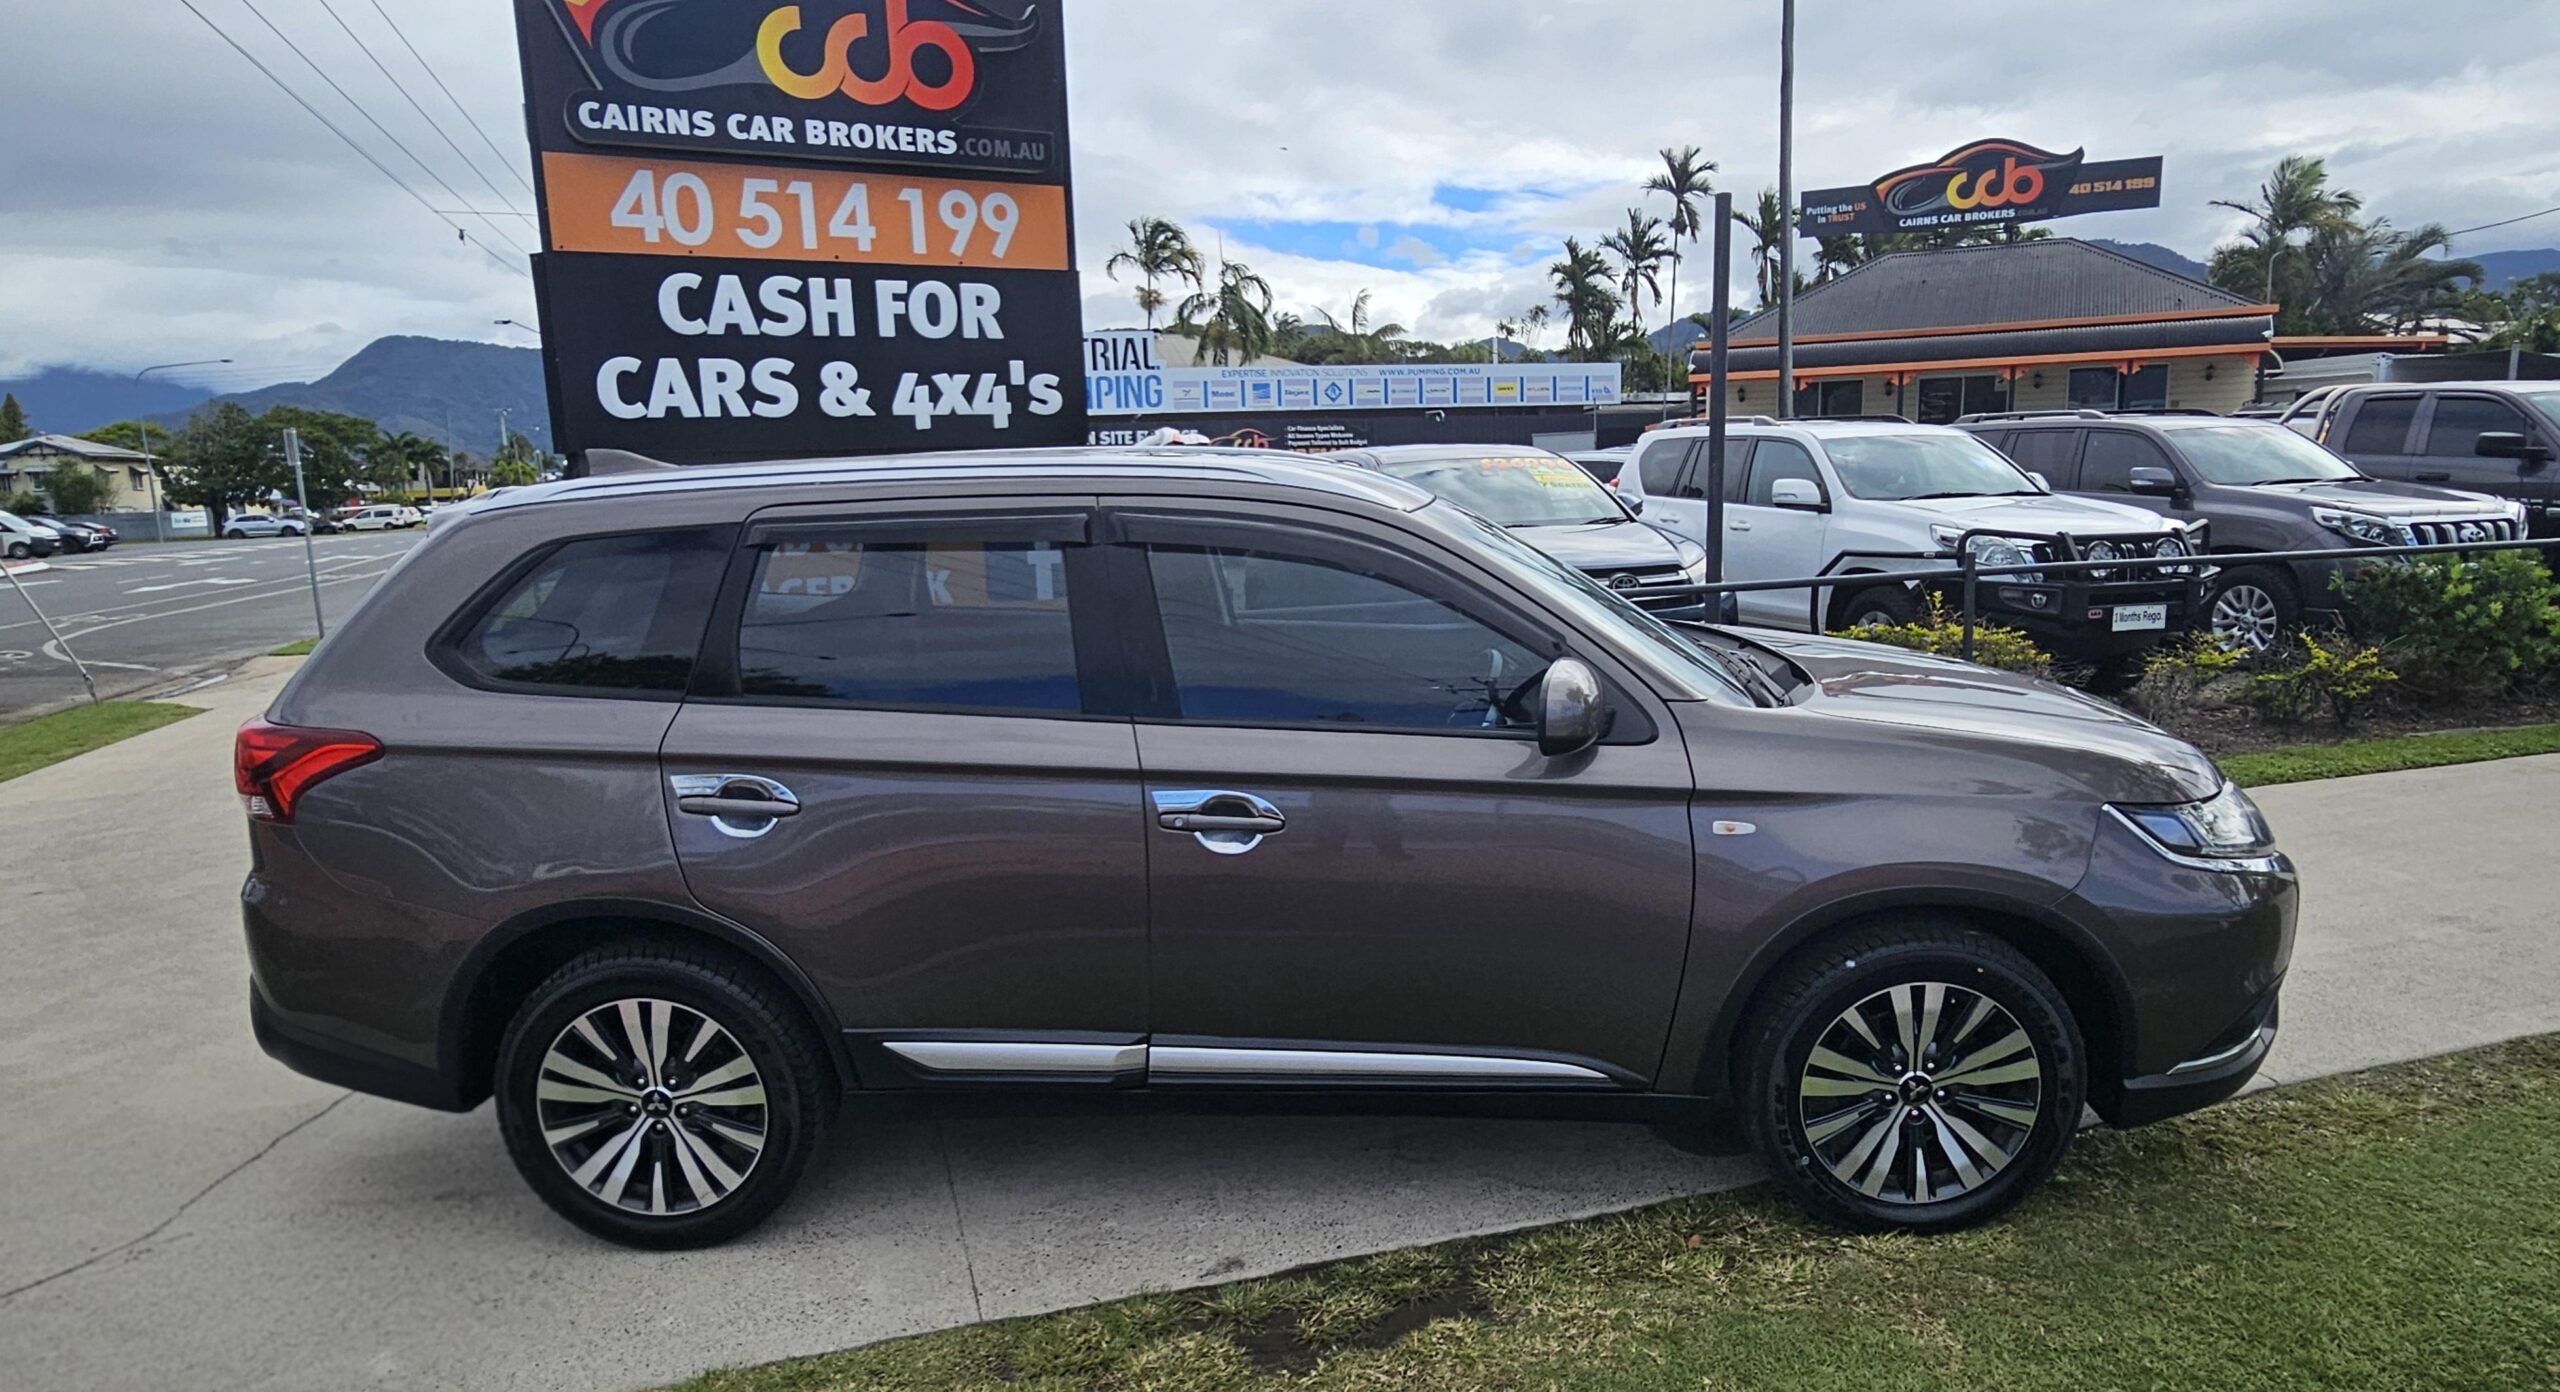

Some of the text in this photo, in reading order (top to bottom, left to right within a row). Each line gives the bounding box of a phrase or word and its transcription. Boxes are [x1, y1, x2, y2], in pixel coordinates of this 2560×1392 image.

[578, 101, 716, 137] CAIRNS
[726, 113, 796, 144] CAR
[805, 119, 958, 155] BROKERS
[1946, 157, 2043, 209] ccb
[2068, 182, 2092, 195] 40
[2093, 179, 2122, 193] 514
[610, 169, 1020, 260] 40 514 199
[1806, 202, 1867, 216] Putting the US
[1817, 212, 1855, 224] in TRUST
[1899, 214, 1938, 227] CAIRNS
[1940, 213, 1962, 224] CAR
[1964, 208, 2016, 222] BROKERS
[658, 272, 1005, 339] CASH FOR
[1221, 366, 1481, 378] EXPERTISE INNOVATION SOLUTIONS WWW.PUMPING.COM.AU
[596, 355, 800, 420] CARS
[818, 361, 877, 417] &
[1099, 431, 1134, 445] SITE
